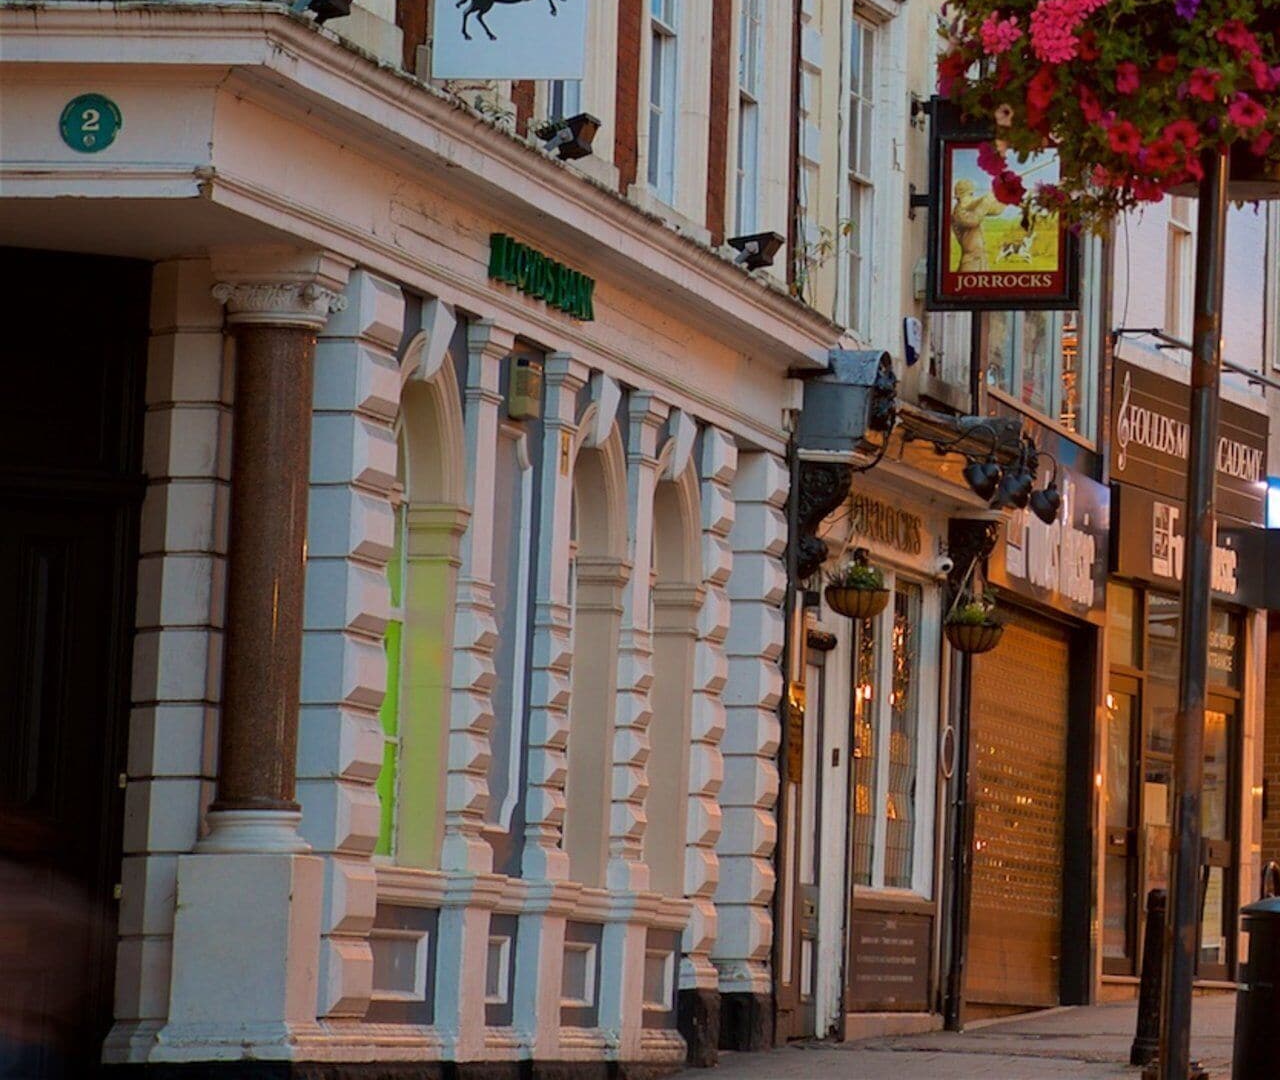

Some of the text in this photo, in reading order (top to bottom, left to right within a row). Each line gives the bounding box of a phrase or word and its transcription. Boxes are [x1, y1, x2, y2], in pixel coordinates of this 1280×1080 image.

[81, 108, 100, 132] 2
[954, 273, 1053, 293] JORROCKS
[1129, 405, 1175, 456] FOULDS
[1217, 436, 1264, 483] CADEMY
